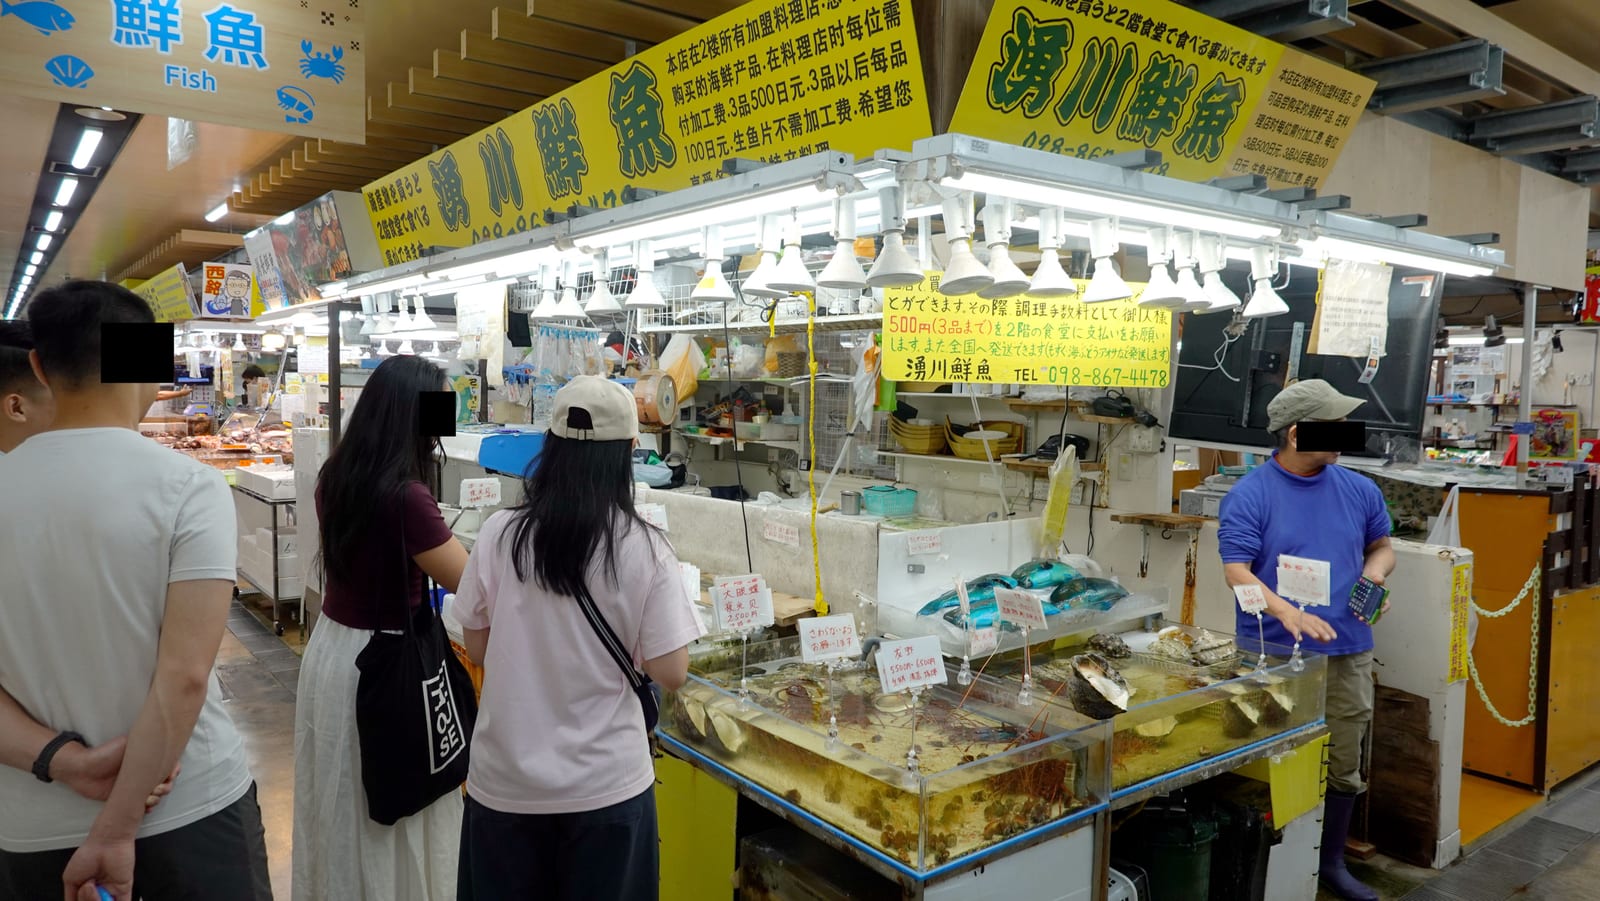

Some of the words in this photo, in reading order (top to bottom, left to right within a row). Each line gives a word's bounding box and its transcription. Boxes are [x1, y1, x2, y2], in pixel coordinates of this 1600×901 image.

[165, 64, 217, 92] Fish
[1014, 368, 1038, 381] TEL
[1048, 365, 1168, 388] 098-867-4478
